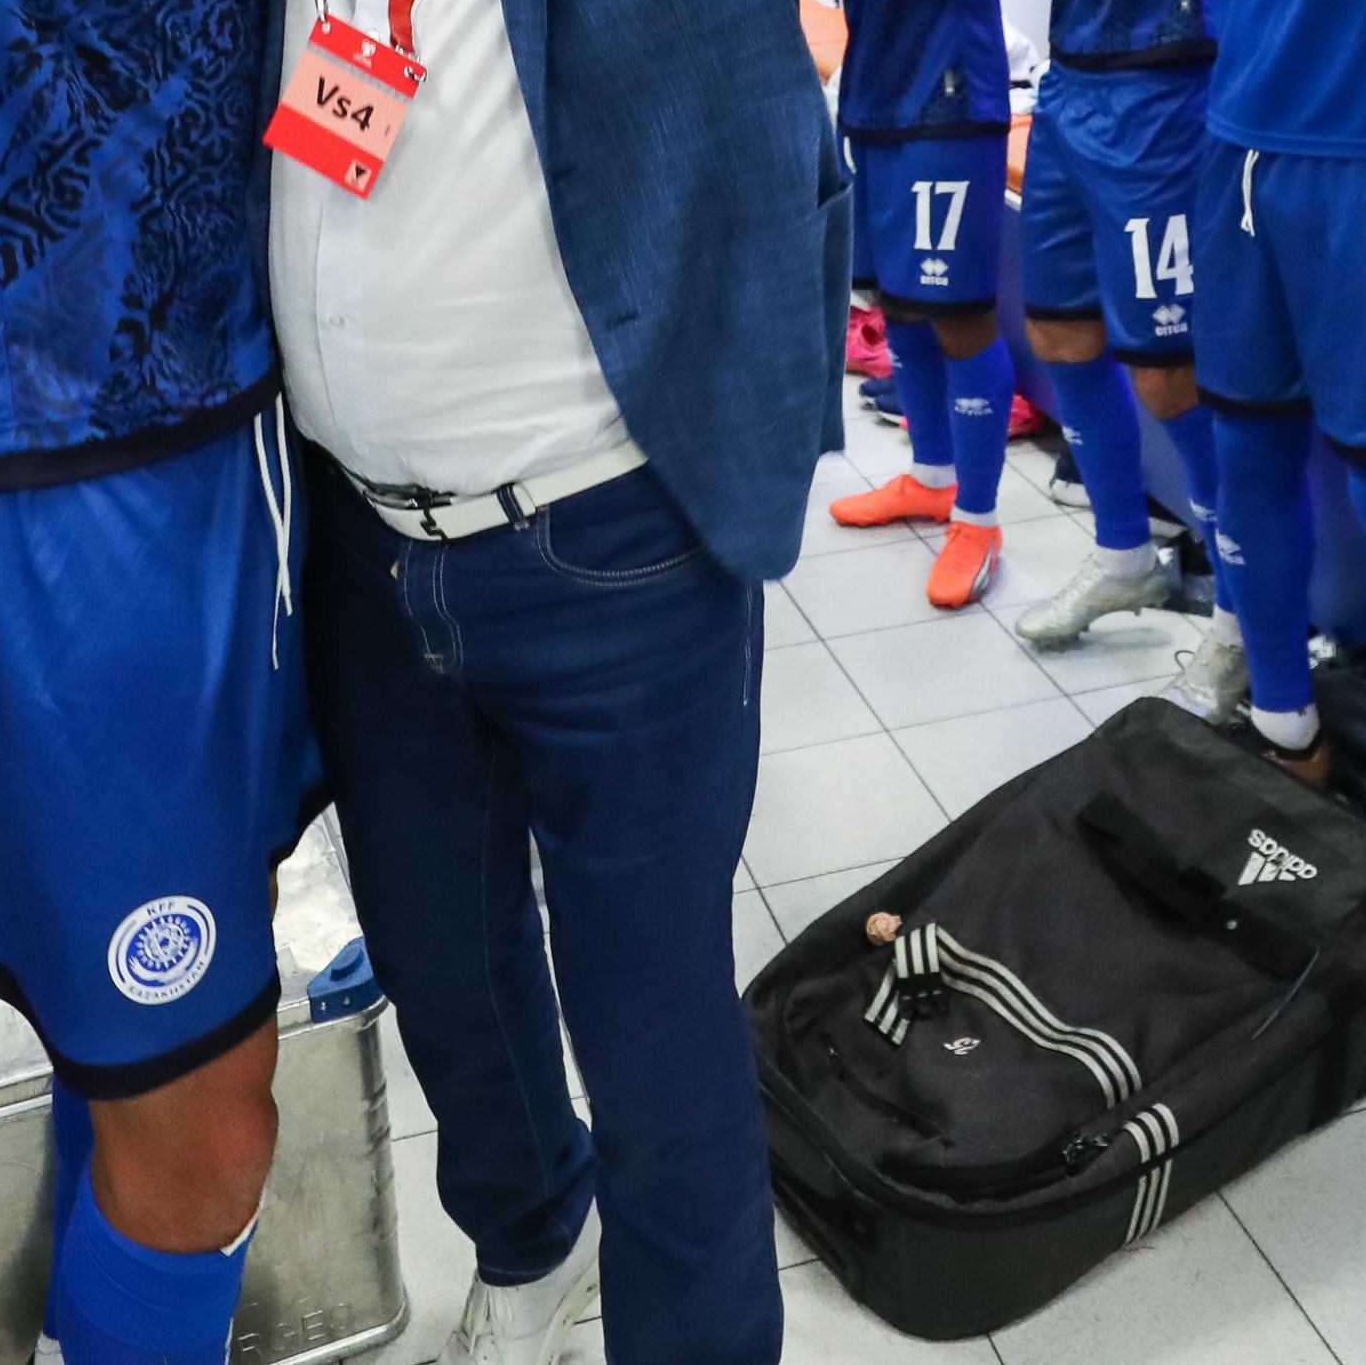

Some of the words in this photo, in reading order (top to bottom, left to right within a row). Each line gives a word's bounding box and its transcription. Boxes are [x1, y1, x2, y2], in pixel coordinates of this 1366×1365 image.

[316, 75, 375, 132] Vs4
[911, 181, 971, 251] 17
[1124, 214, 1195, 299] 14
[1247, 828, 1318, 880] adidas
